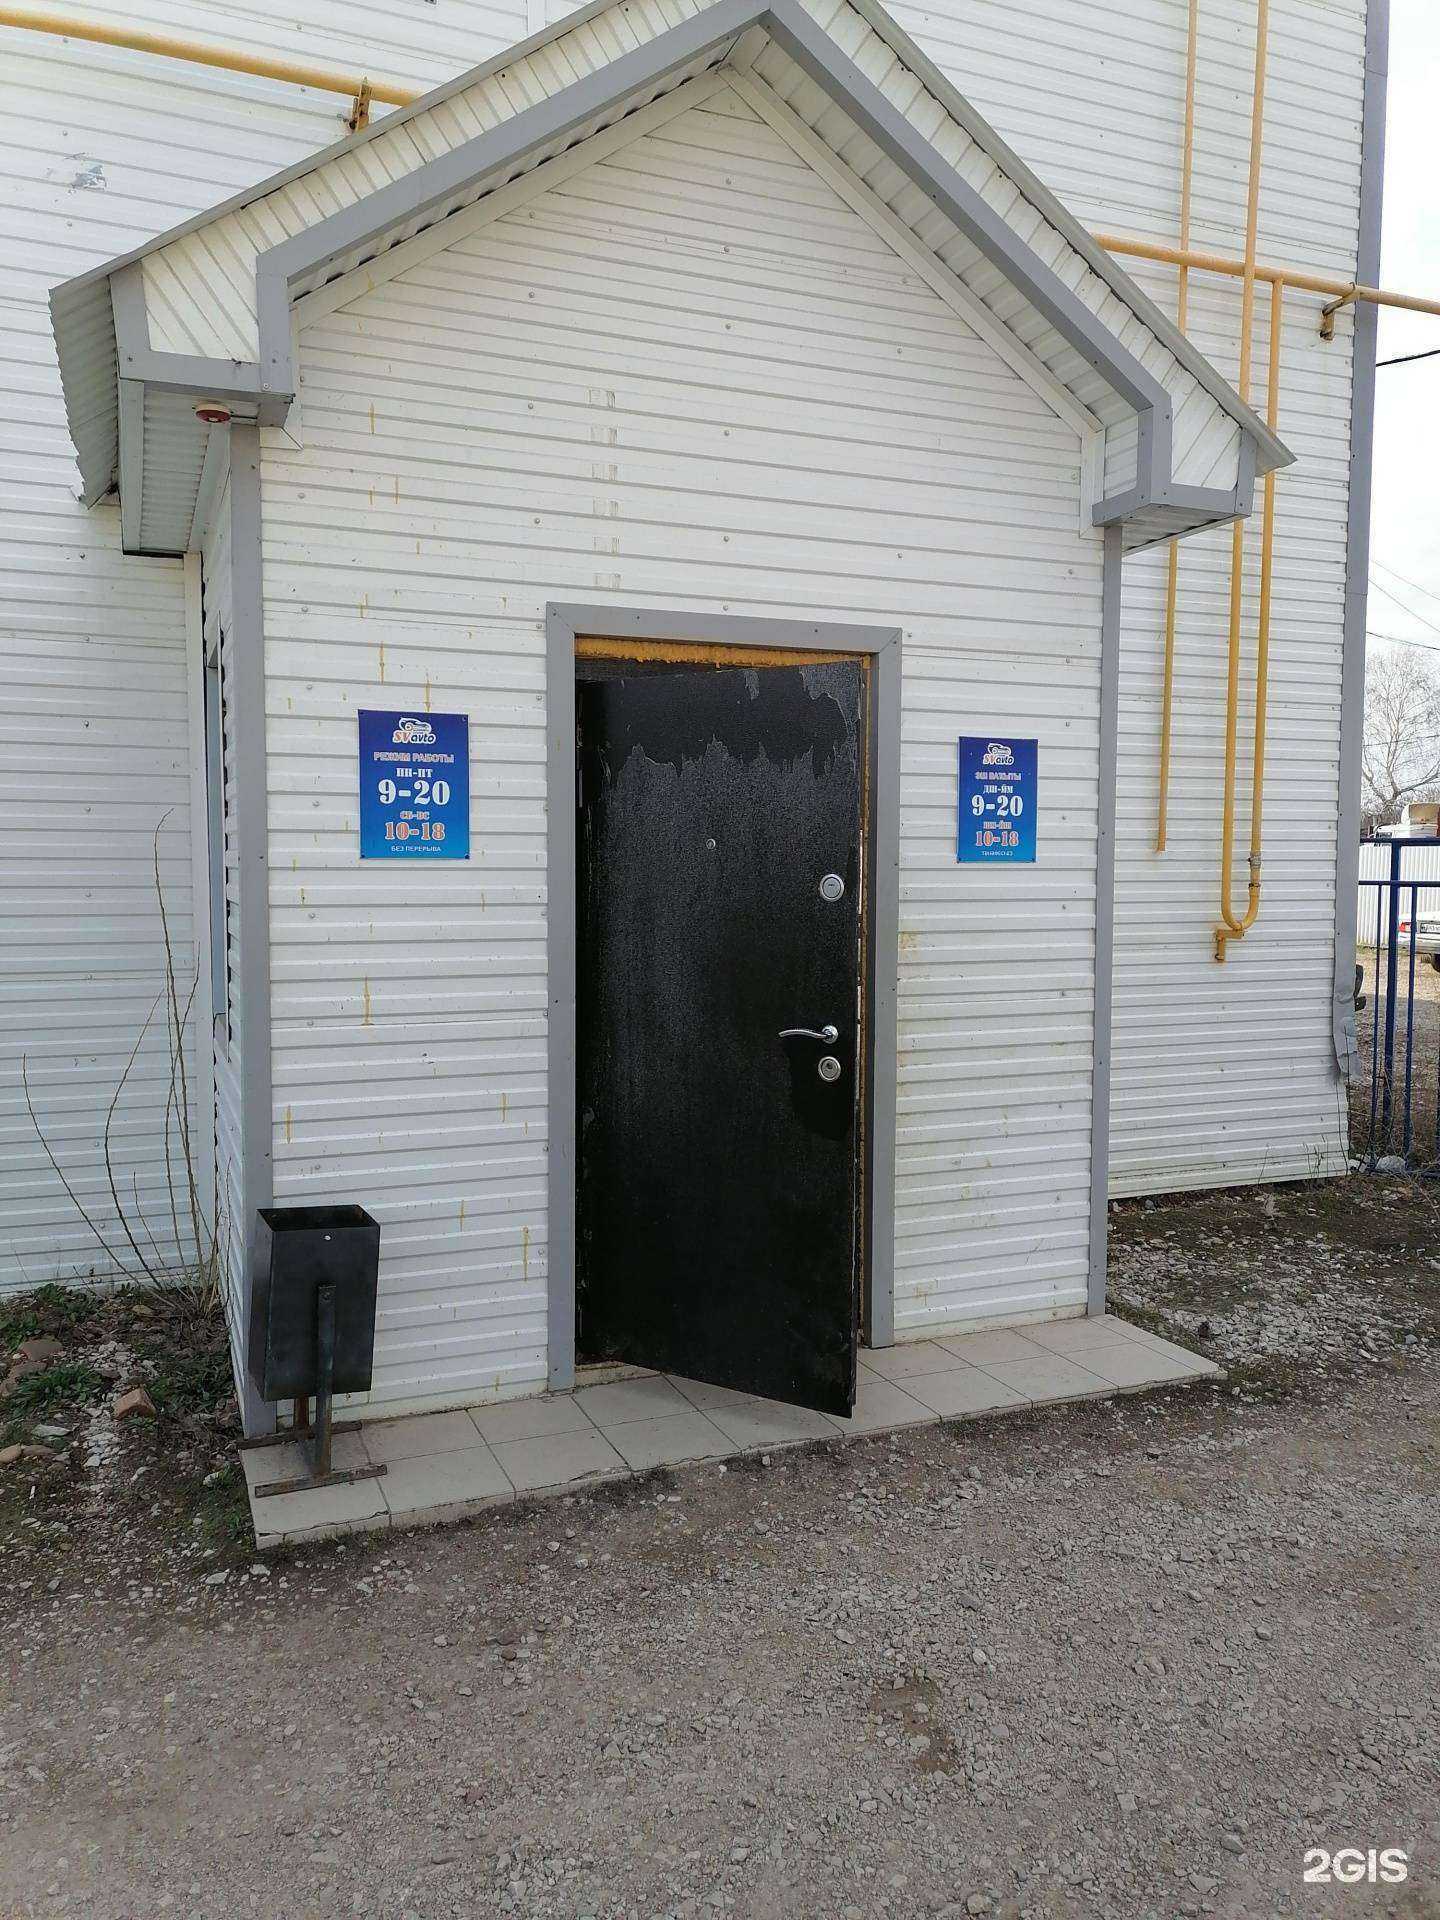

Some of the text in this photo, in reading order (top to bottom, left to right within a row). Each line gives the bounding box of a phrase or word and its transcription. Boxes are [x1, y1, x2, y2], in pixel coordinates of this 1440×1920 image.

[373, 751, 455, 763] РЕЖИМ РАБОТЫ
[396, 767, 433, 778] ПН-ПТ
[378, 779, 450, 805] 9-20
[972, 795, 1023, 816] 9-20
[384, 821, 446, 841] 10-18
[975, 831, 1019, 846] 10-18
